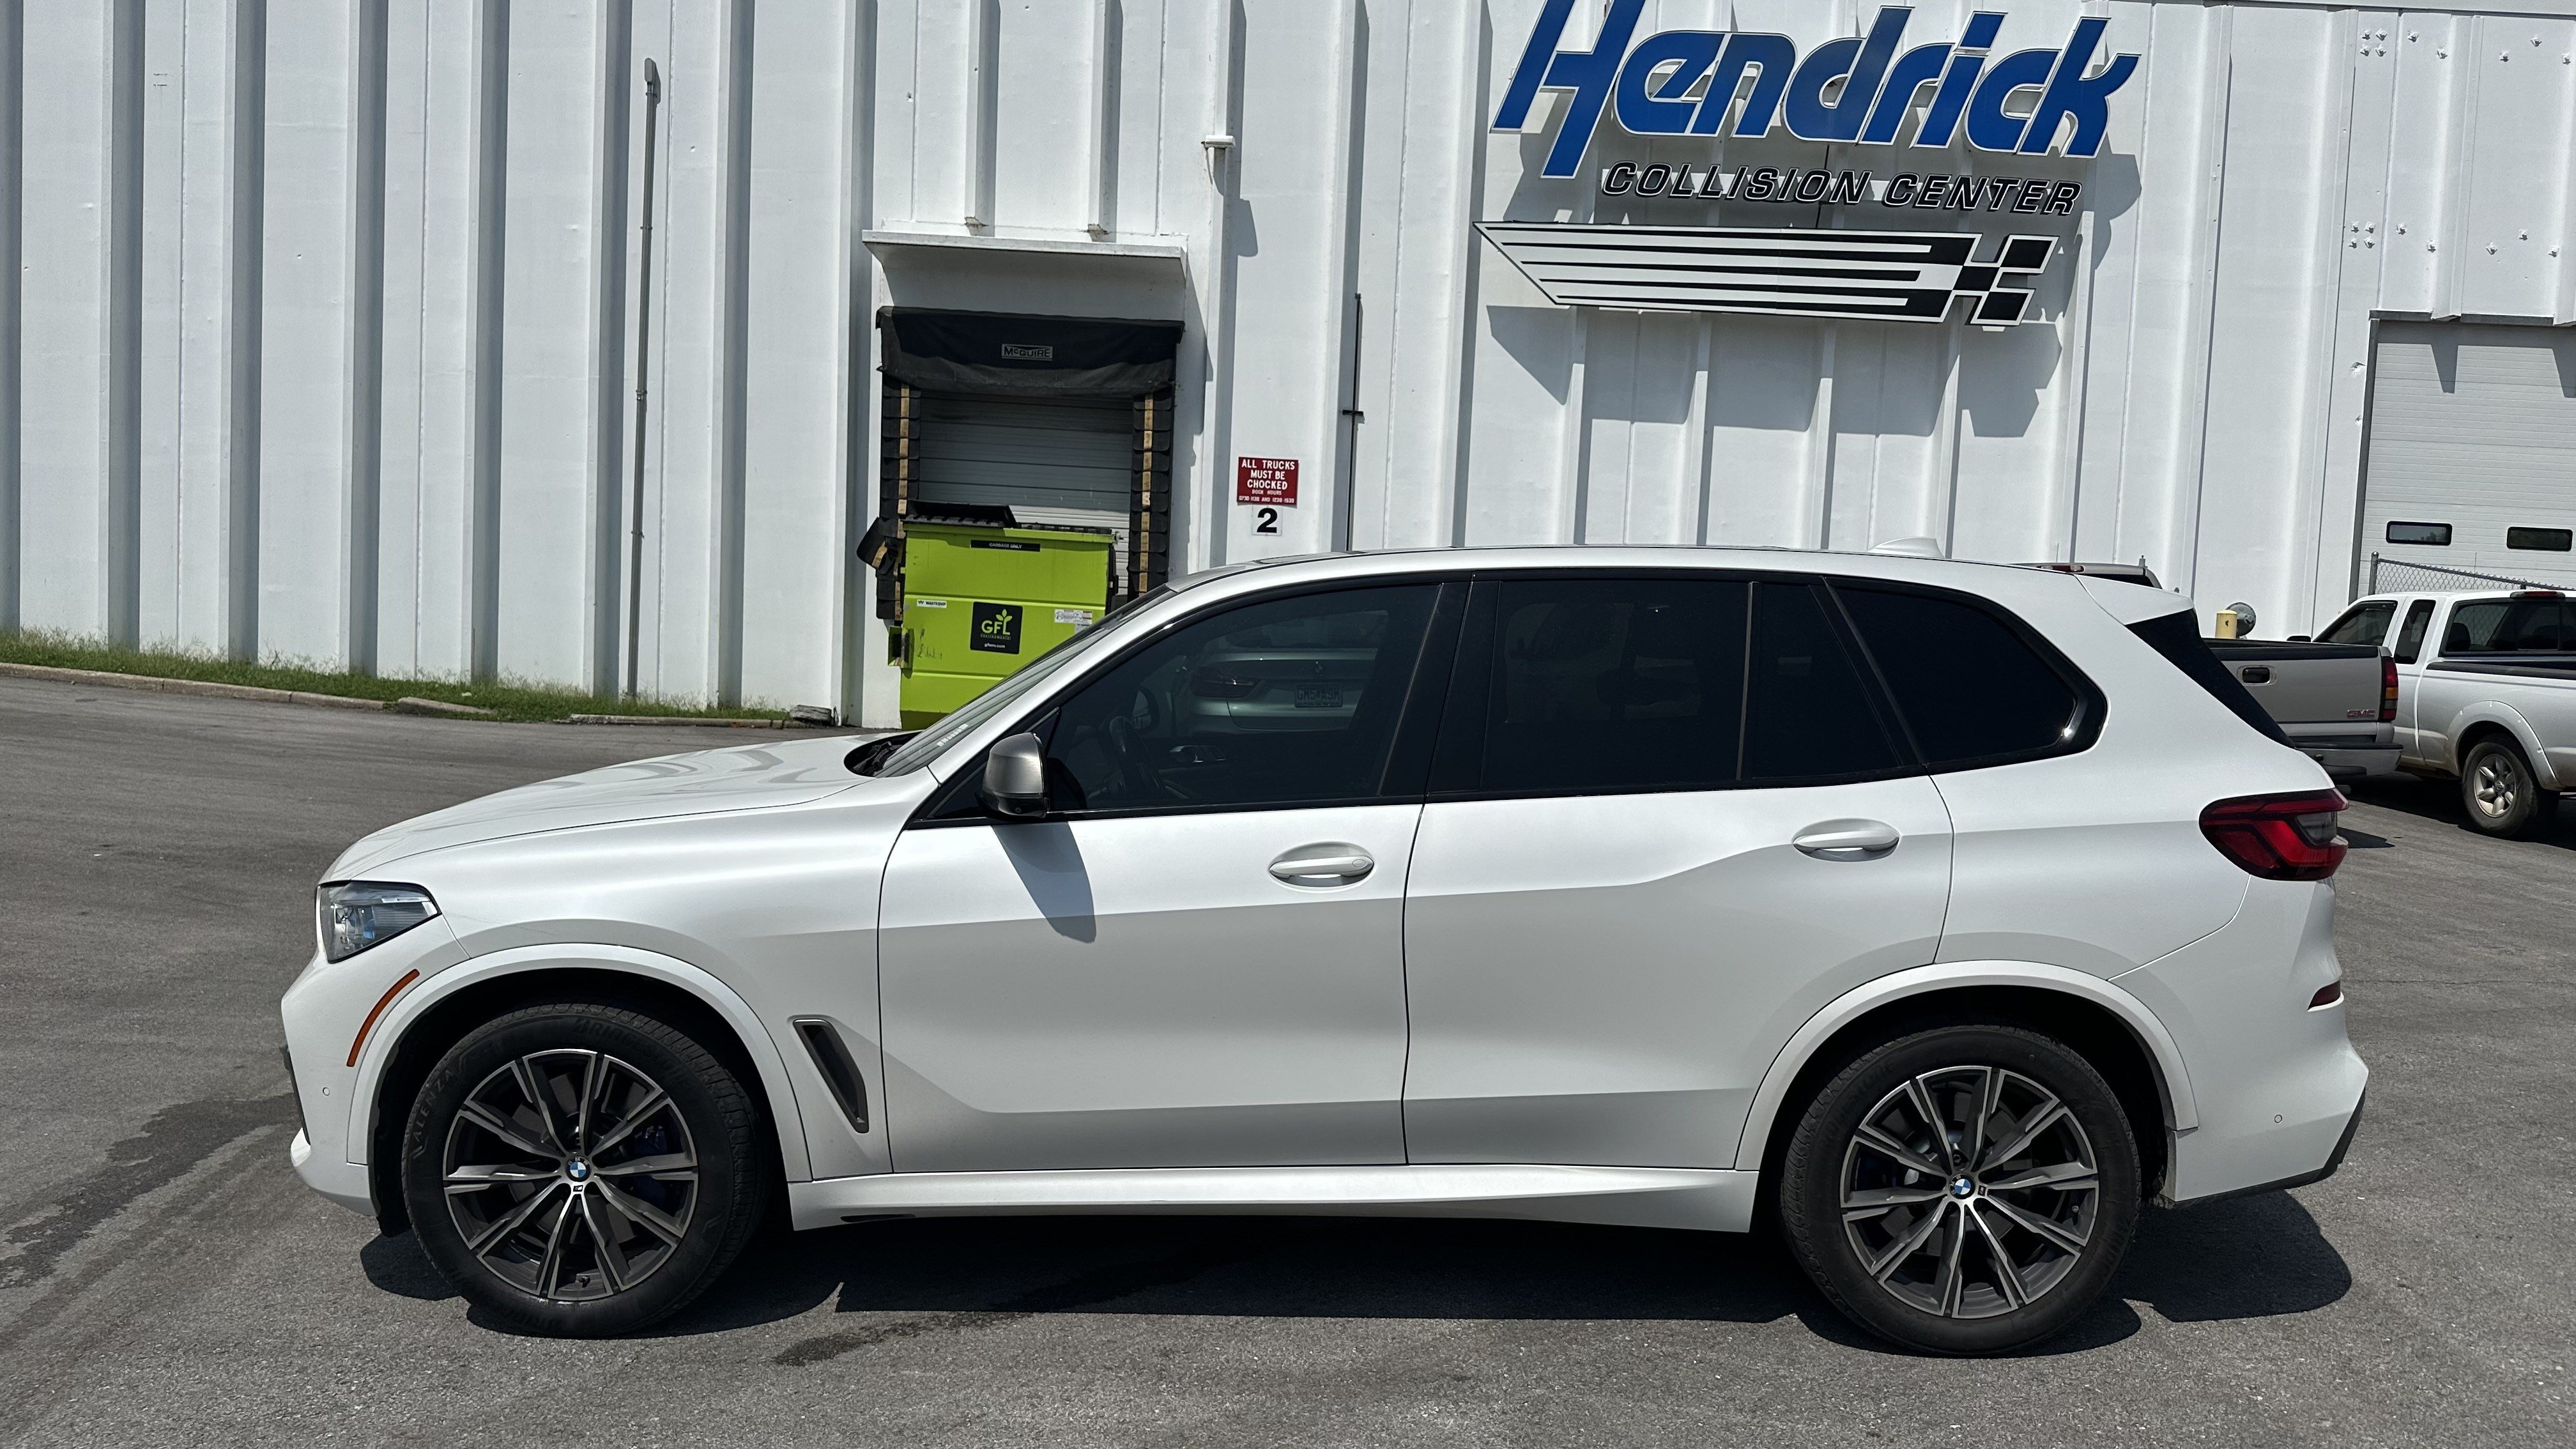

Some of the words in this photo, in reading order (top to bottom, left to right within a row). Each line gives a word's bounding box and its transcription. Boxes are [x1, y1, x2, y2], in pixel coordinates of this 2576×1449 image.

[1489, 0, 2142, 180] Hendrick
[1601, 160, 1874, 205] COLLISION
[1882, 172, 2083, 217] CENTER
[1241, 459, 1257, 468] ALL
[1262, 460, 1295, 470] TRUCKS
[1250, 470, 1273, 479] MUST
[1275, 471, 1285, 480] BE
[1247, 479, 1288, 490] CHOCKED
[1257, 507, 1278, 533] 2
[981, 617, 1012, 635] GFL
[413, 1068, 454, 1142] ALENZA
